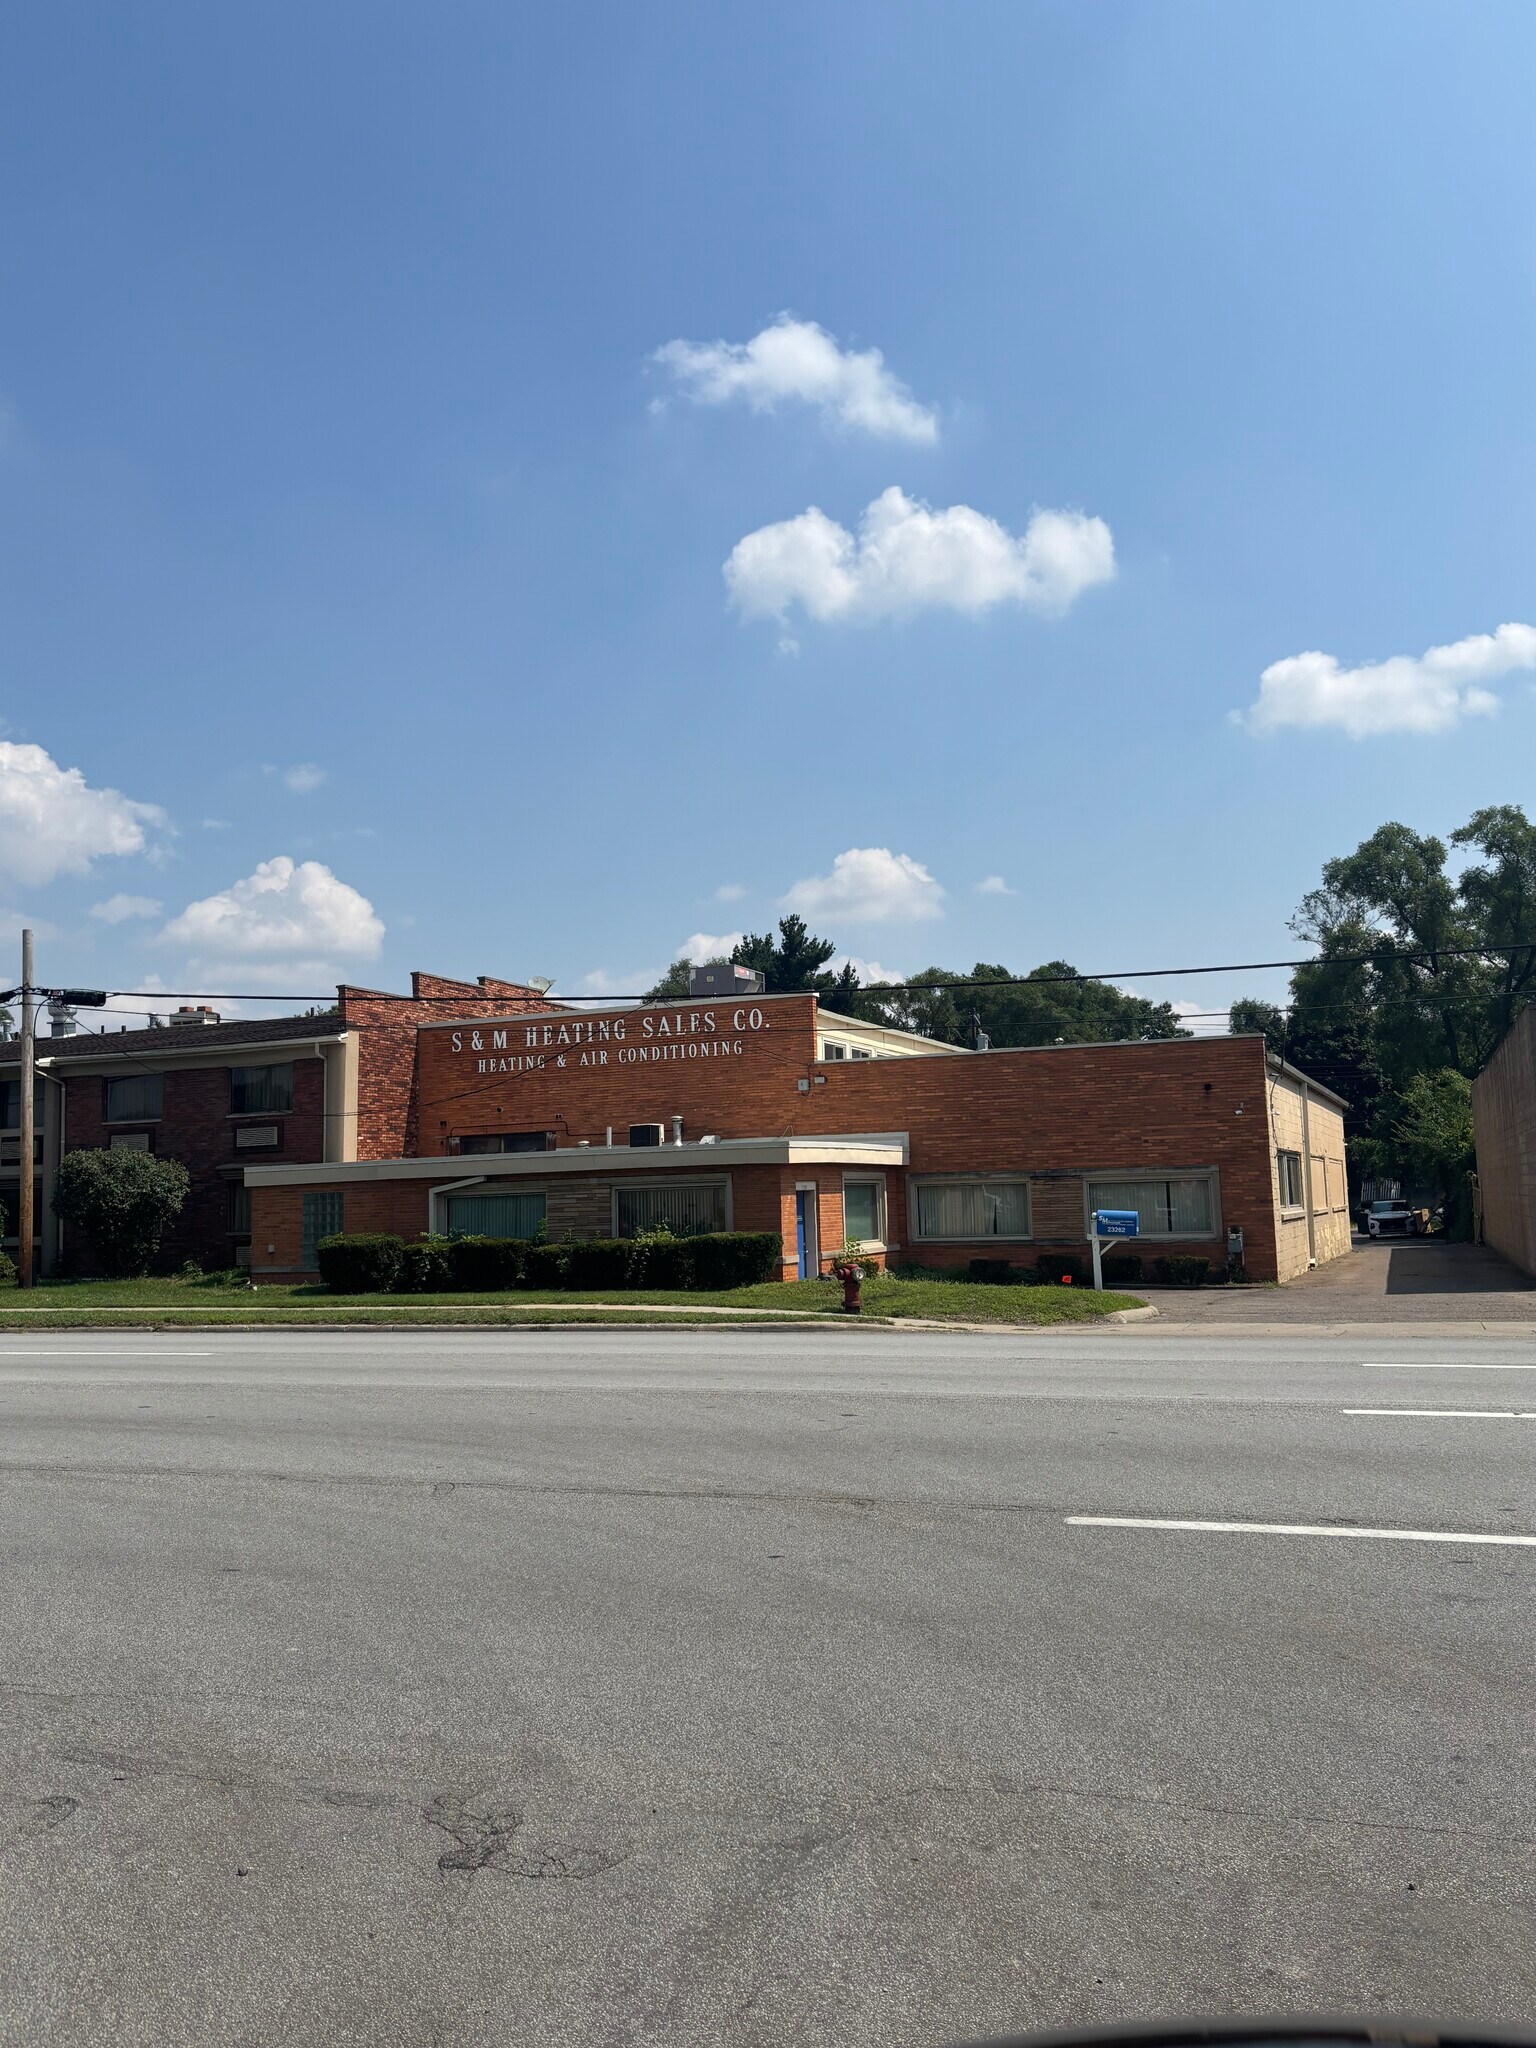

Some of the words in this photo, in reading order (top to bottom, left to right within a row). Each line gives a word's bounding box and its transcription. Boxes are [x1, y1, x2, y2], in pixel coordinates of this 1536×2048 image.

[526, 1019, 626, 1048] HEATING
[642, 1011, 716, 1039] SALES
[733, 1008, 771, 1031] CO.
[478, 1055, 545, 1074] HEATING
[556, 1054, 567, 1068] &
[579, 1050, 608, 1066] AIR
[618, 1040, 743, 1064] CONDITIONING
